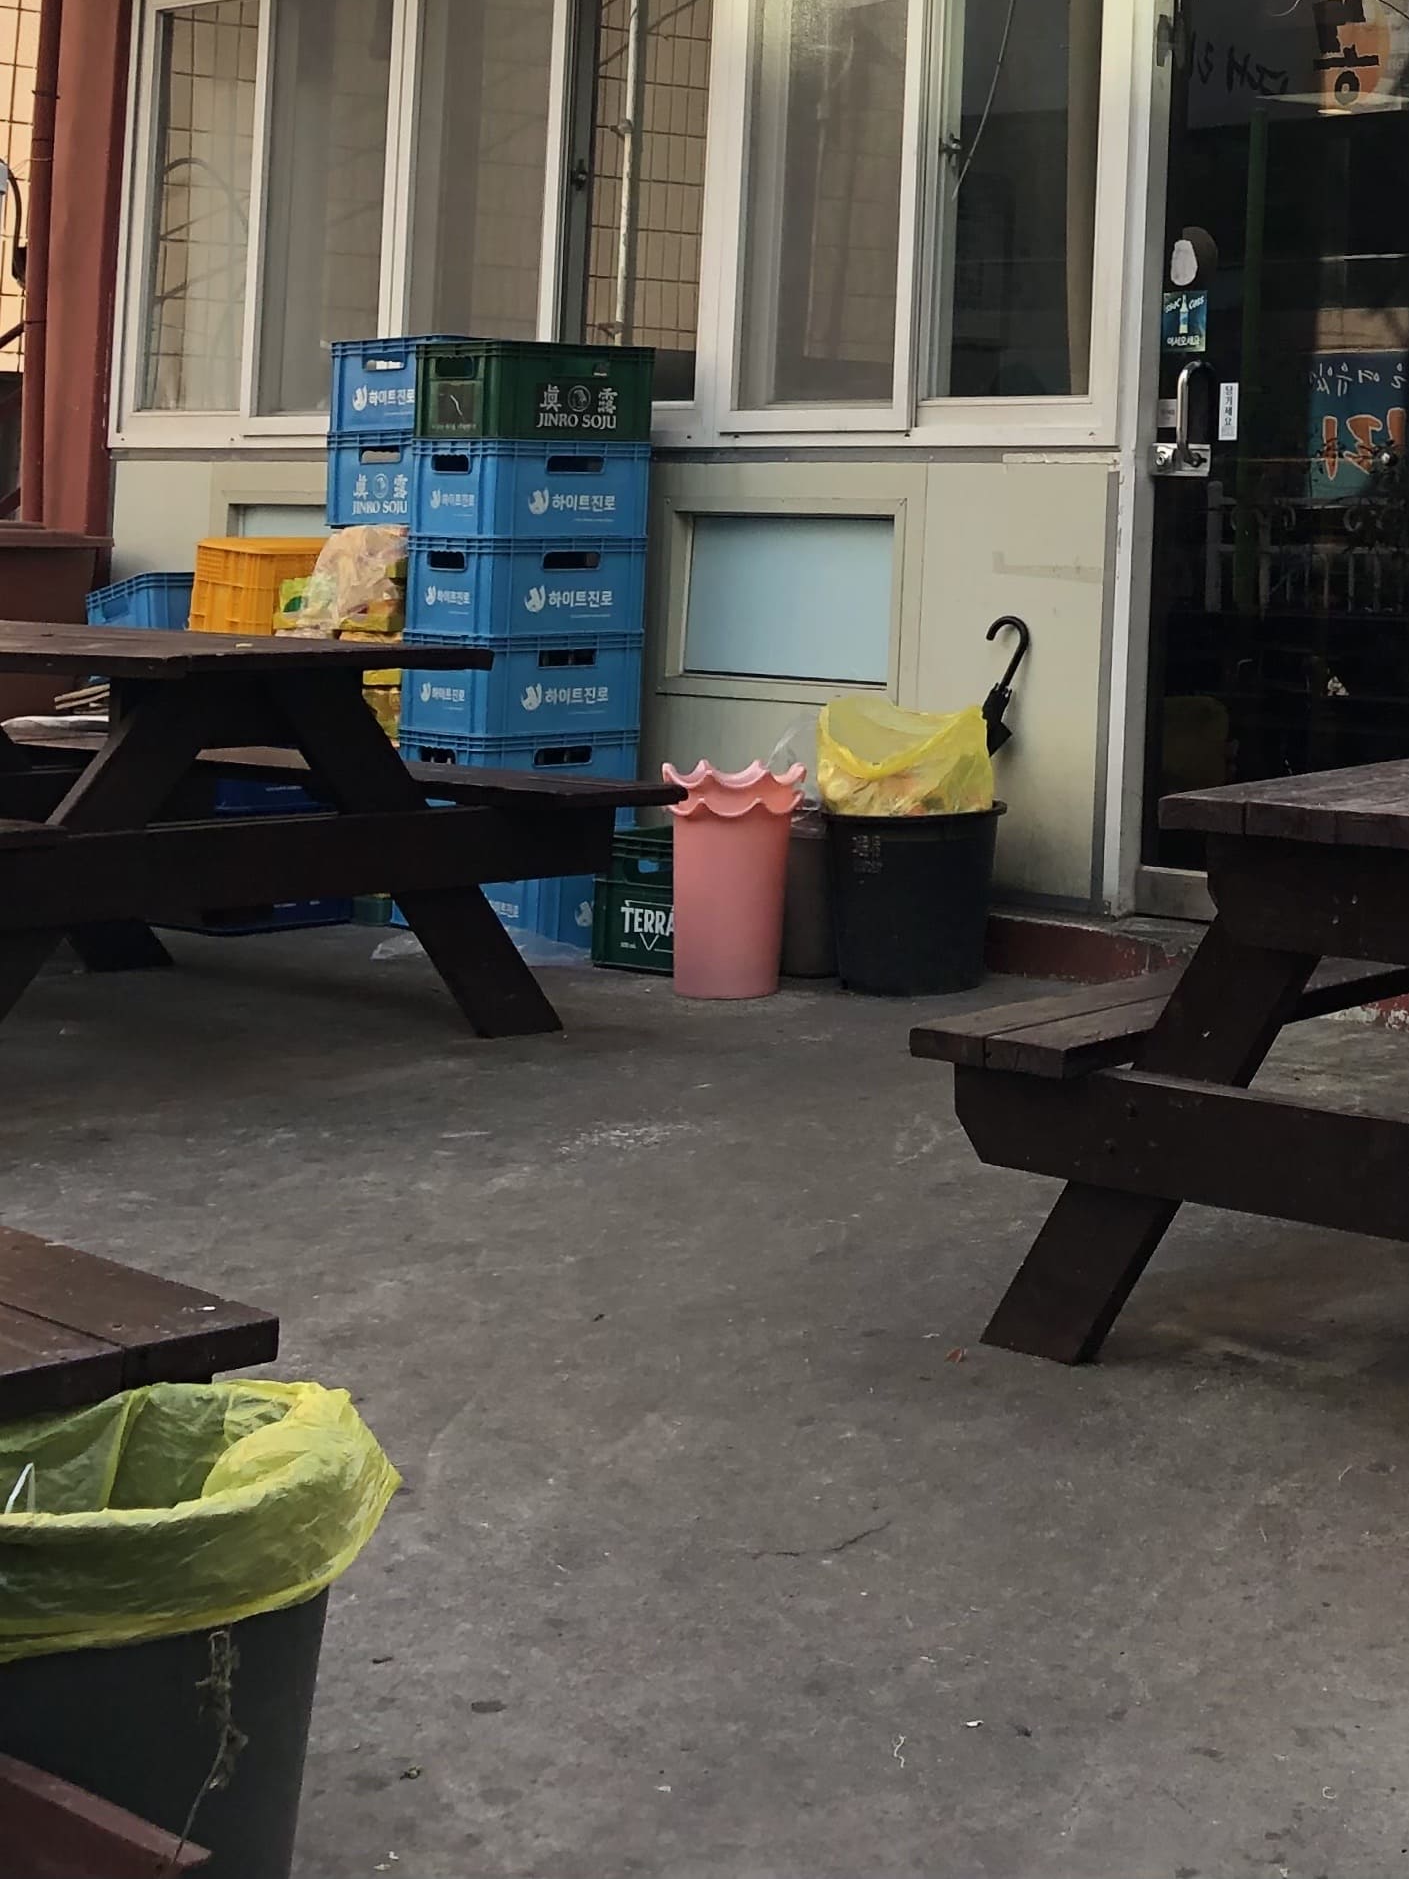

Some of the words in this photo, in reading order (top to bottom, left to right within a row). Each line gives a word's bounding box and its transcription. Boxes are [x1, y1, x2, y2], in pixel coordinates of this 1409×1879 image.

[368, 388, 415, 407] 하이트진로
[535, 412, 578, 429] JINRO
[581, 414, 617, 430] SOJU
[352, 500, 381, 515] JINRO
[382, 500, 408, 514] SOJU
[551, 493, 616, 511] 하이트진로
[548, 589, 613, 607] 하이트진로
[544, 685, 609, 705] 하이트진로
[621, 906, 674, 936] TERRA
